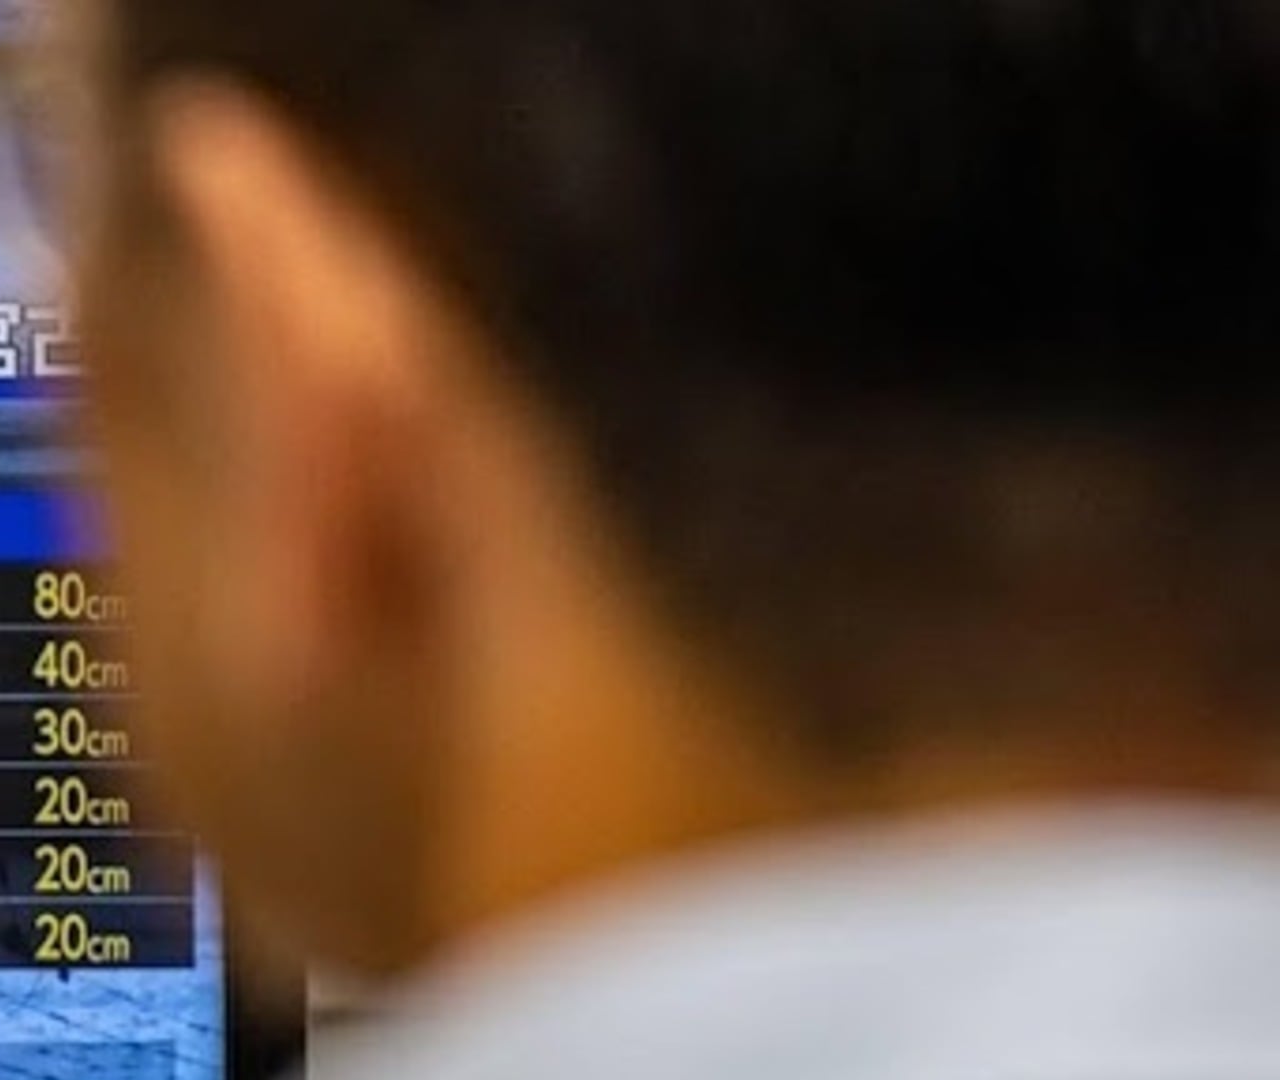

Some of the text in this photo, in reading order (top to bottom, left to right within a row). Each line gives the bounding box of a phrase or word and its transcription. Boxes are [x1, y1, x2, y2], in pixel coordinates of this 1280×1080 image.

[33, 643, 128, 689] 40cm
[33, 711, 128, 757] 30cm
[33, 780, 128, 827] 20cm
[33, 849, 128, 895] 20cm
[33, 918, 128, 963] 20cm
